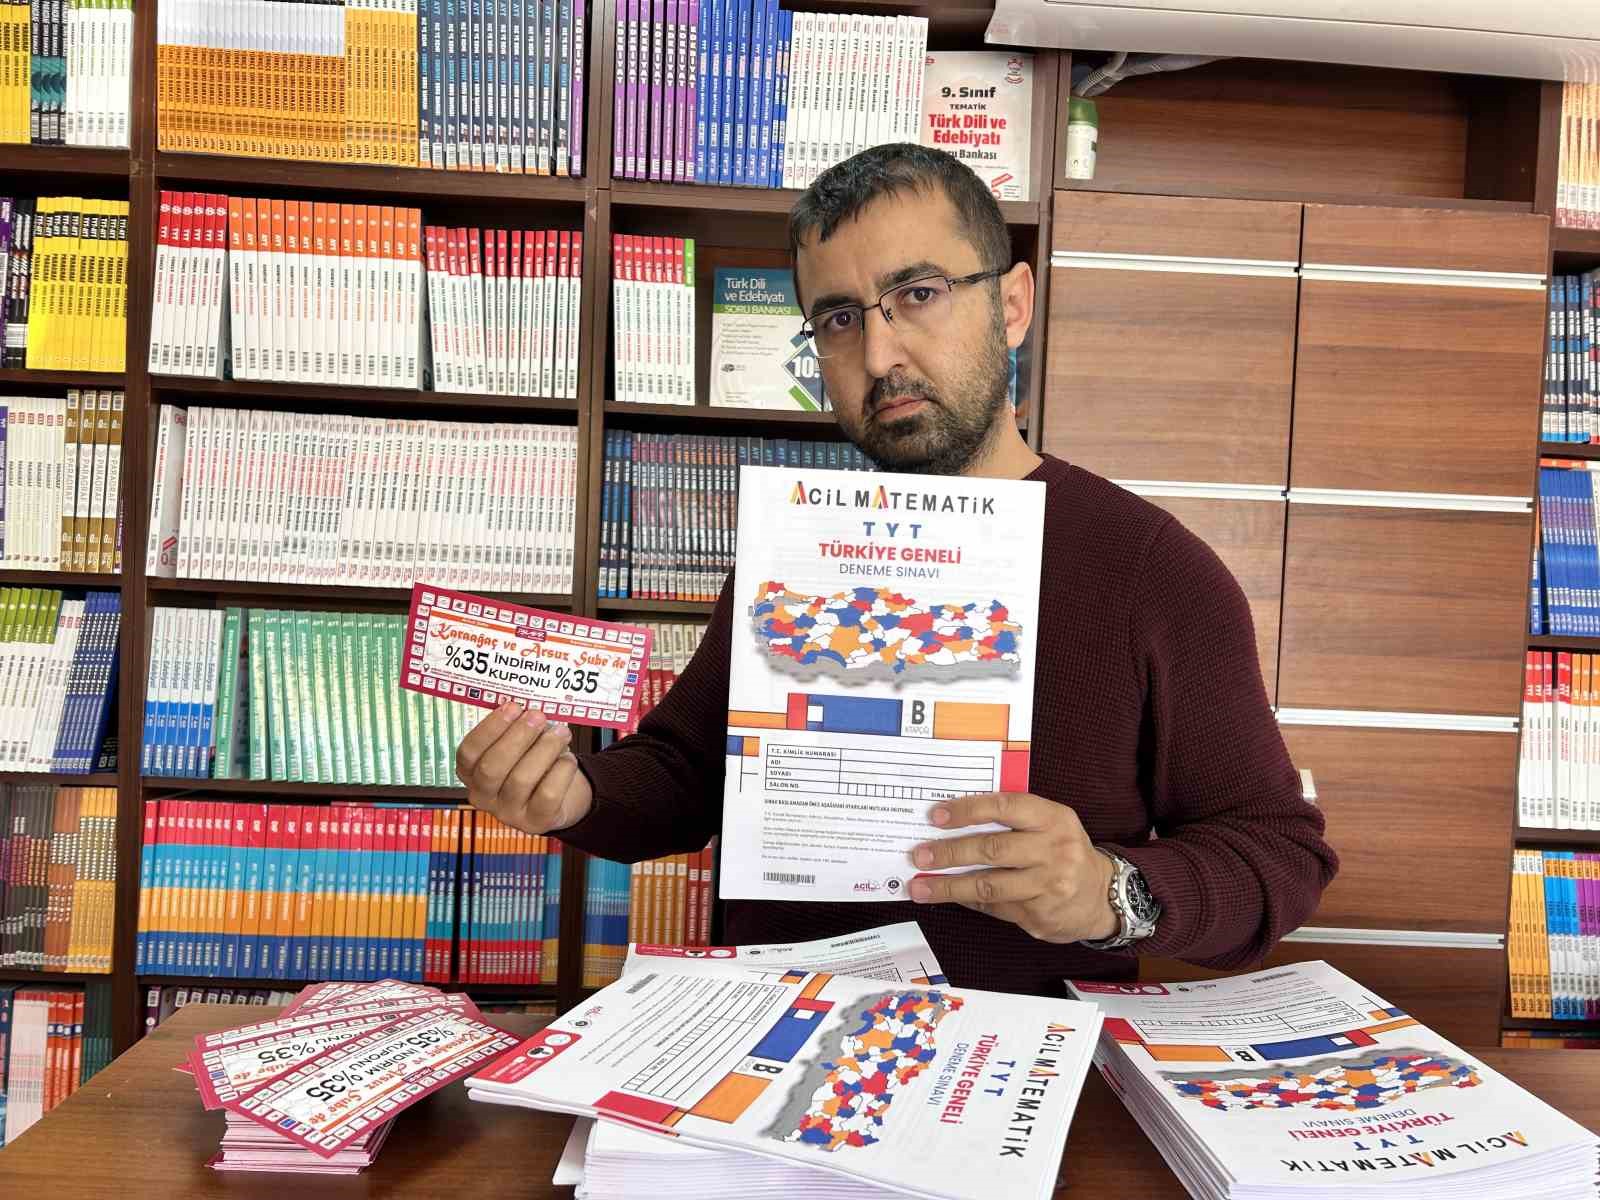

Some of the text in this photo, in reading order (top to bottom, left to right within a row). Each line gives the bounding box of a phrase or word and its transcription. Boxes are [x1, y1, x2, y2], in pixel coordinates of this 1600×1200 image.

[942, 87, 996, 98] 9. Sınıf
[929, 114, 1006, 129] Türk Dili ve
[934, 130, 1000, 147] Edebiyatı
[959, 149, 997, 160] Bankası
[725, 278, 766, 288] Türk Dili
[724, 290, 784, 304] ve Edebiyatı
[724, 305, 791, 314] SORU BANKASI
[64, 458, 74, 501] PARAGRAF
[80, 460, 90, 501] PARAGRAF
[94, 459, 103, 501] PARAGRAF
[109, 460, 118, 501] PARAGRAF
[818, 539, 961, 564] TÜRKİYE GENELİ
[839, 563, 940, 579] DENEME SINAVI
[431, 624, 498, 649] Karaağaç
[504, 641, 516, 651] ve
[520, 643, 568, 661] Arsuz
[445, 645, 489, 674] %35
[494, 652, 550, 673] İNDİRİM
[489, 667, 550, 688] KUPONU
[555, 667, 599, 693] %35
[911, 700, 925, 725] B
[408, 1026, 455, 1049] %35
[258, 1042, 316, 1065] %35
[350, 1042, 410, 1072] KUPONU
[364, 1048, 422, 1076] İNDİRİM
[1235, 1050, 1255, 1062] B
[752, 1062, 783, 1076] B
[927, 1042, 969, 1106] DENEME SINAVI
[939, 1034, 999, 1124] TÜRKİYE GENELİ
[306, 1070, 363, 1102] %35
[1288, 1112, 1456, 1141] TÜRKİYE GENELİ
[1302, 1108, 1416, 1128] DENEME SINAVI
